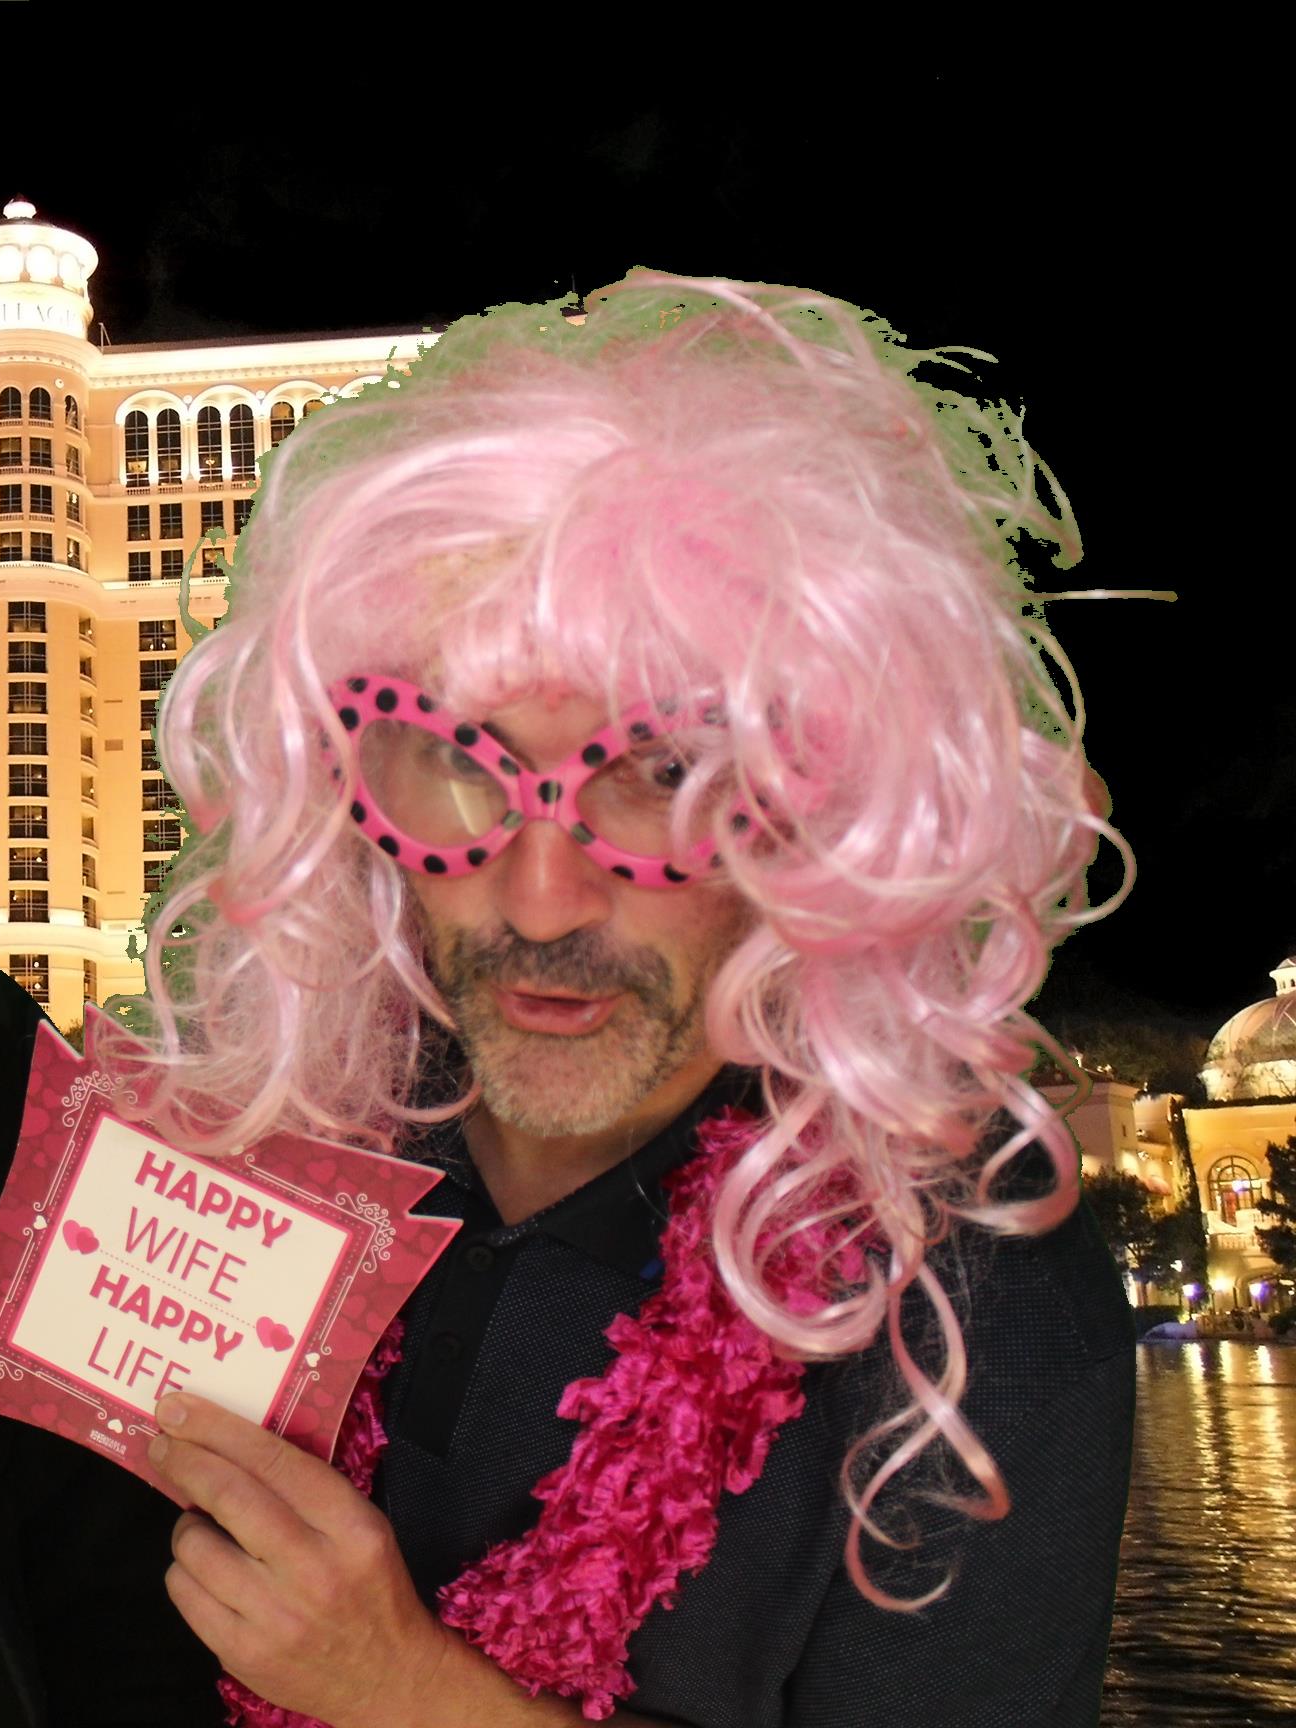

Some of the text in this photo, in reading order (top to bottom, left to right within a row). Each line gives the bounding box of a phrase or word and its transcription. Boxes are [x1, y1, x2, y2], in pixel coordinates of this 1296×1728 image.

[134, 1150, 292, 1248] HAPPY
[123, 1206, 247, 1302] WIFE
[89, 1264, 244, 1362] HAPPY
[86, 1326, 192, 1402] LIFE
